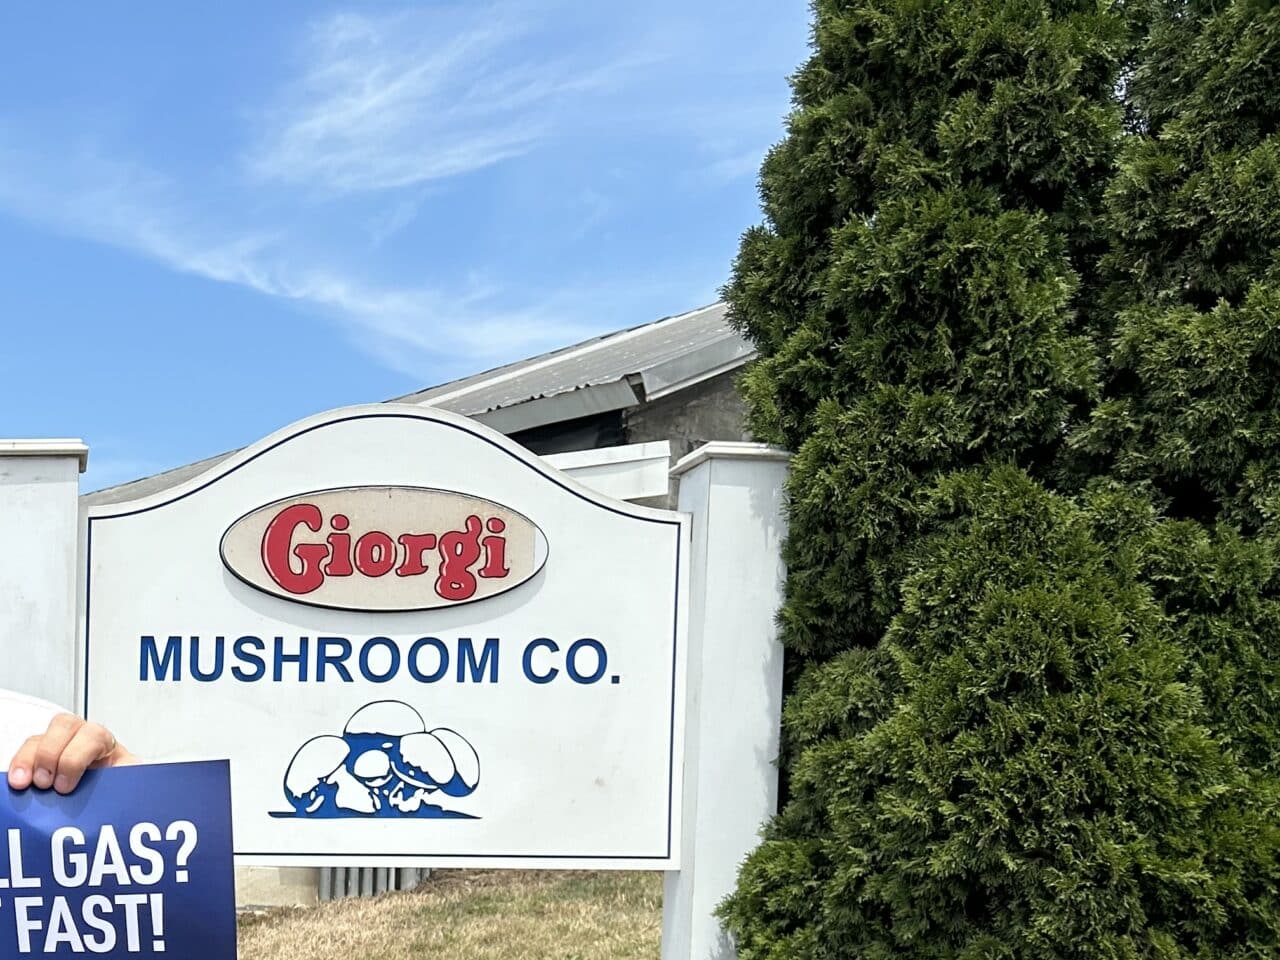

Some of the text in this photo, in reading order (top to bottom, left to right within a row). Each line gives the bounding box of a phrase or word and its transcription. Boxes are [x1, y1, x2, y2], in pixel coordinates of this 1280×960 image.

[260, 503, 511, 600] Giorgi
[139, 636, 620, 684] MUSHROOM CO.
[51, 820, 198, 888] GAS?
[14, 893, 166, 953] FAST!
